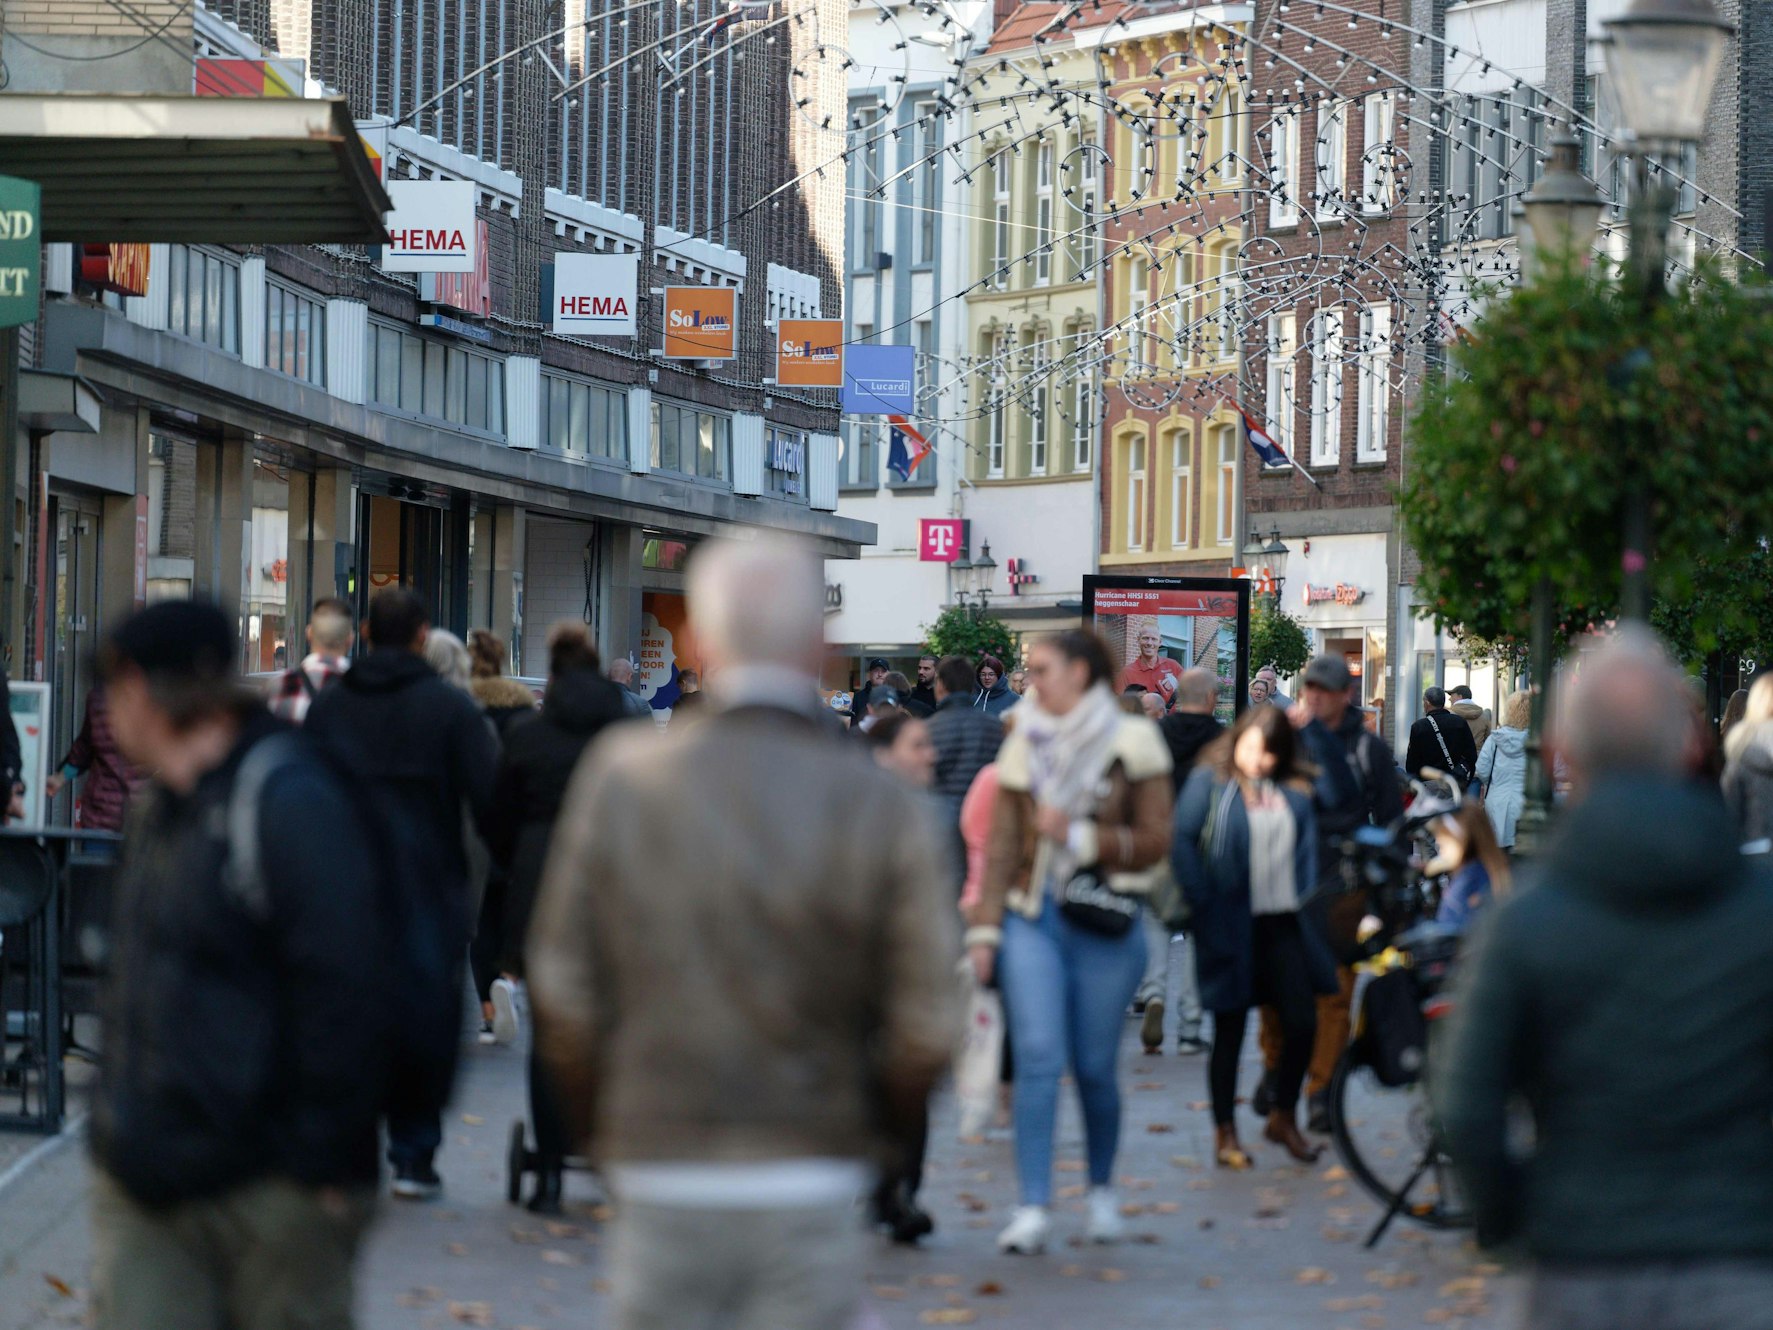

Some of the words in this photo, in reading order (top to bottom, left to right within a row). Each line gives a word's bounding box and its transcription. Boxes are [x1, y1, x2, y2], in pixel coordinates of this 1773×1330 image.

[390, 229, 466, 250] HEMA
[560, 296, 628, 316] HEMA
[670, 309, 729, 328] SoLow
[871, 382, 908, 391] Lucardi
[929, 525, 953, 556] T
[1094, 591, 1126, 599] Hurricane
[1094, 599, 1140, 607] heggenschaar
